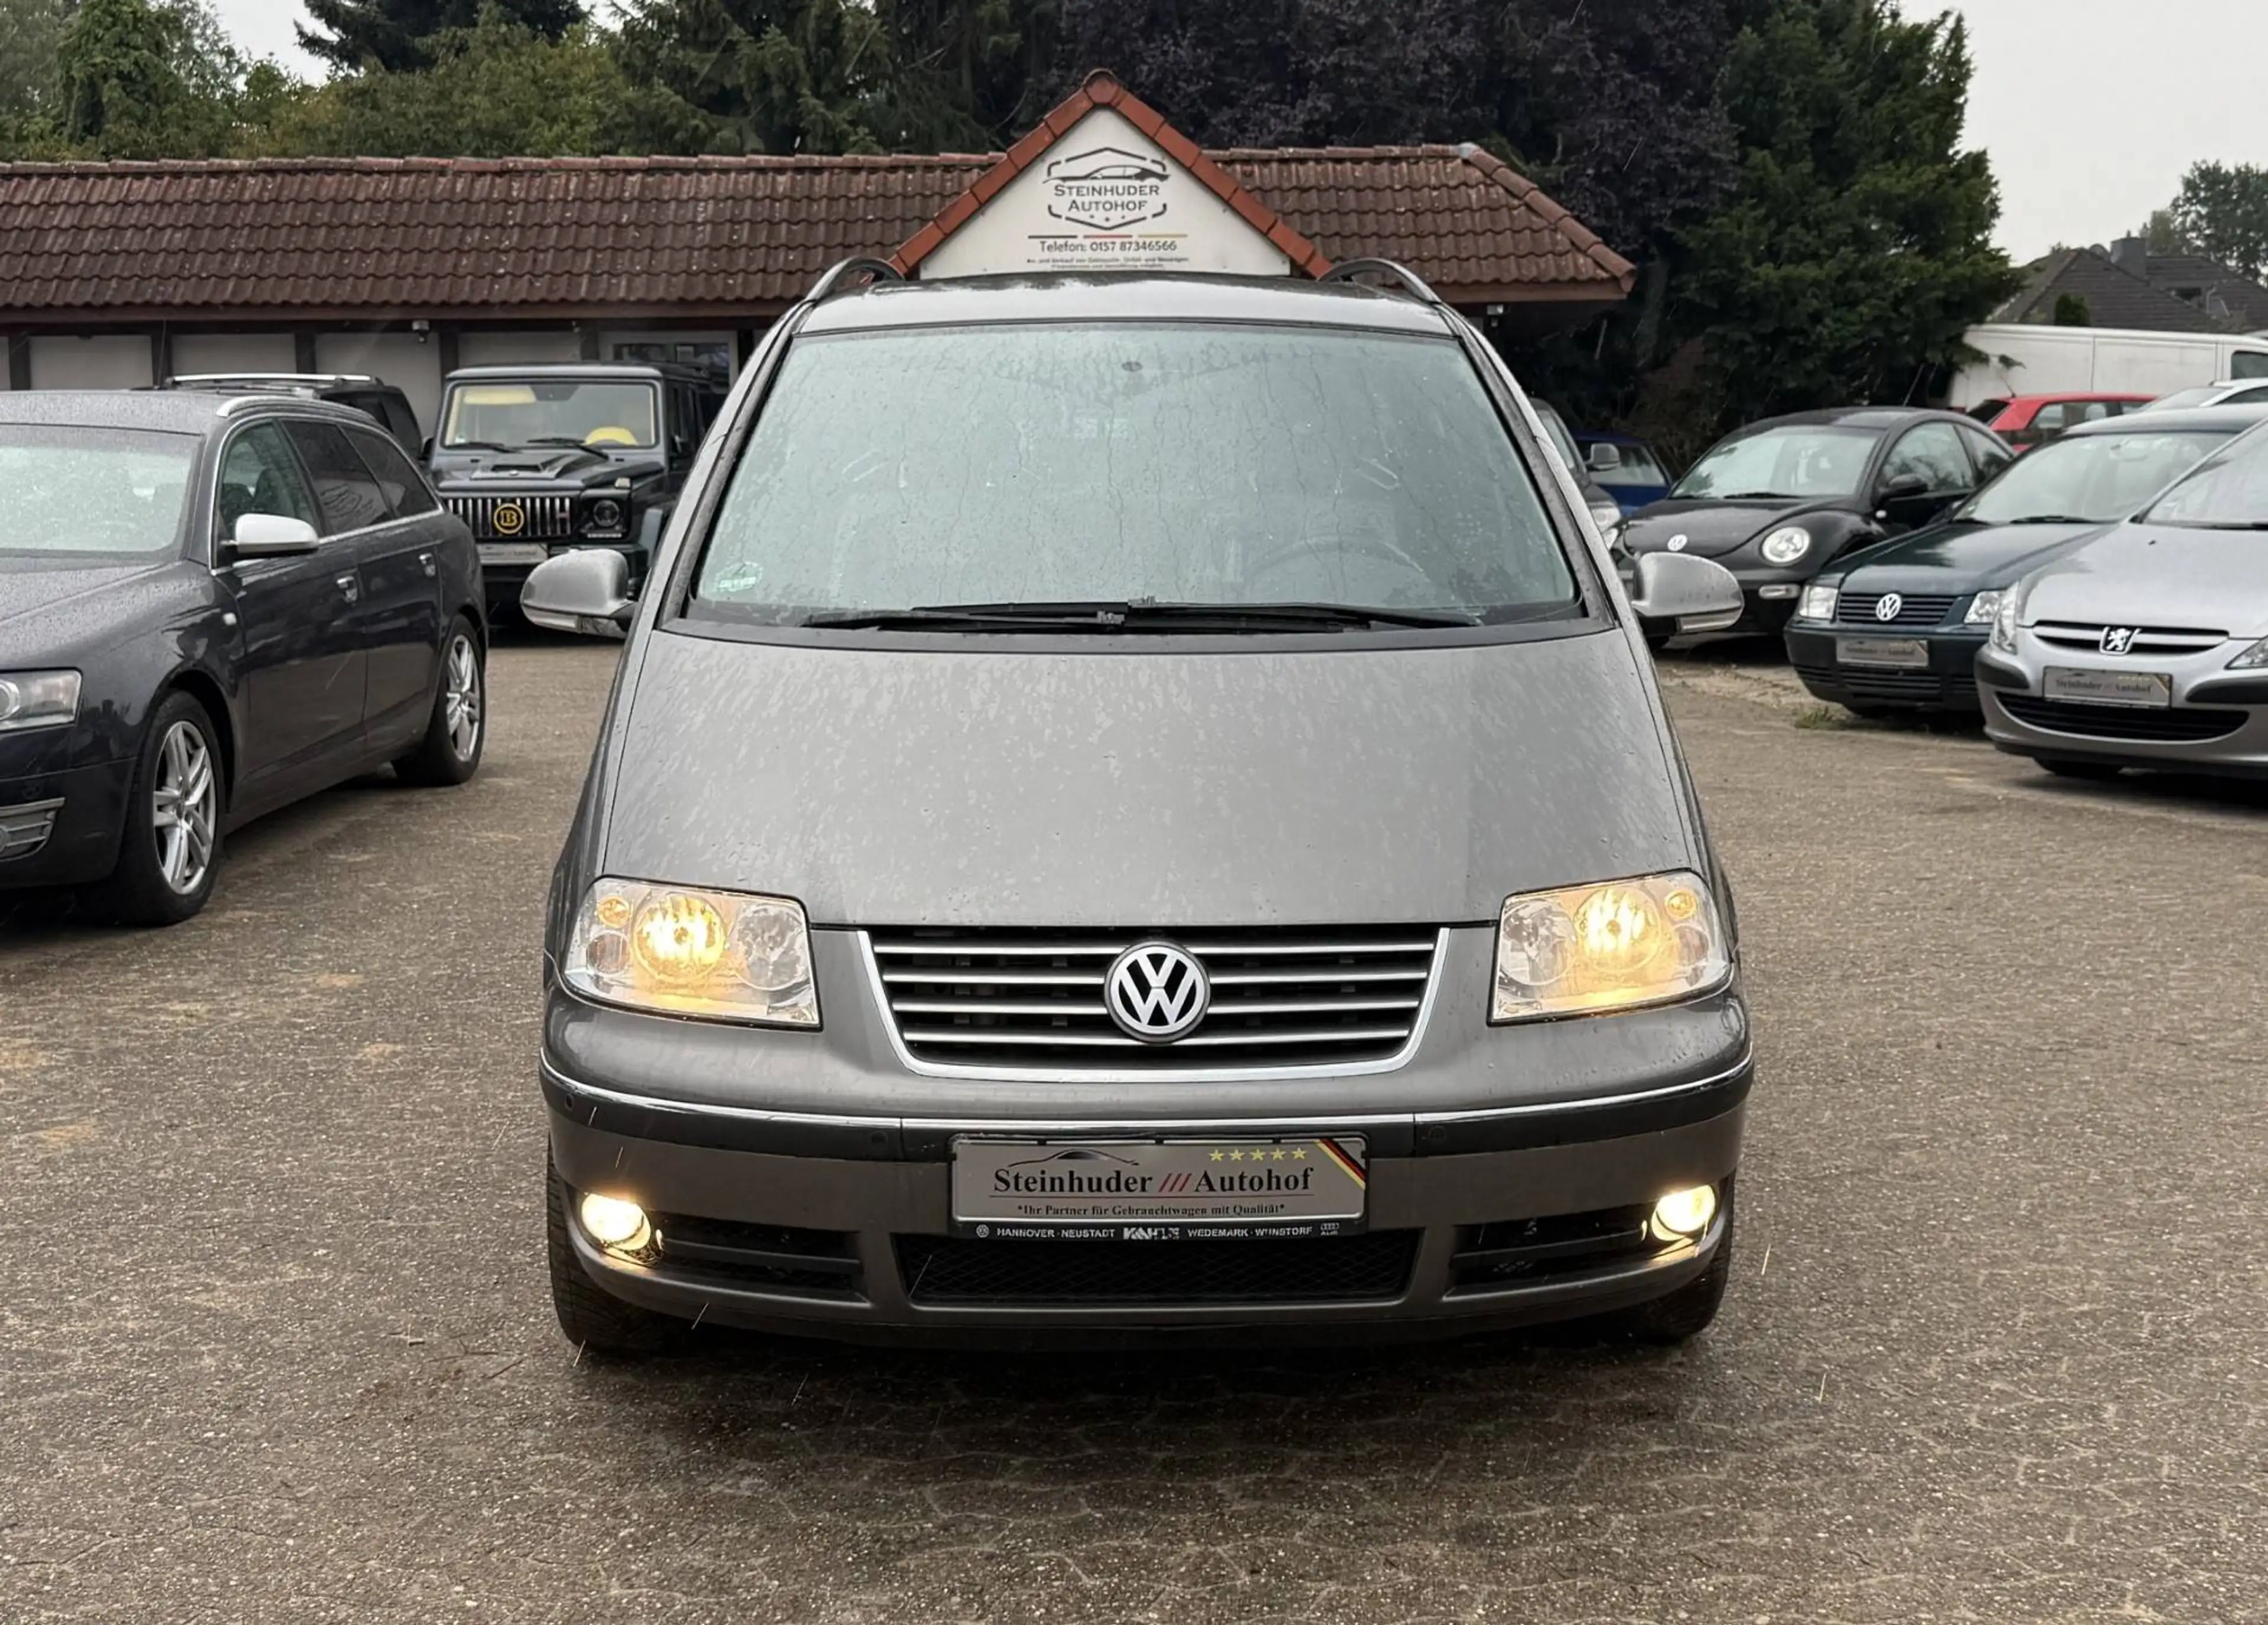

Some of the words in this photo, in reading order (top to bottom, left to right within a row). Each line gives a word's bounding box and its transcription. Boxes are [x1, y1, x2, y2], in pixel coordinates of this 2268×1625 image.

[1054, 184, 1160, 197] STEINHUDER
[1068, 200, 1148, 211] AUTOHOF
[1040, 240, 1087, 253] Telefon:
[1090, 241, 1116, 253] 0157
[1119, 240, 1177, 252] 87346566
[994, 1169, 1153, 1193] Steinhuder
[1195, 1167, 1314, 1192] Autohof
[1045, 1205, 1089, 1216] Partner
[996, 1228, 1055, 1238] HANNOVER
[1061, 1228, 1116, 1238] NEUSTADT
[1187, 1228, 1249, 1238] WEDEMARK
